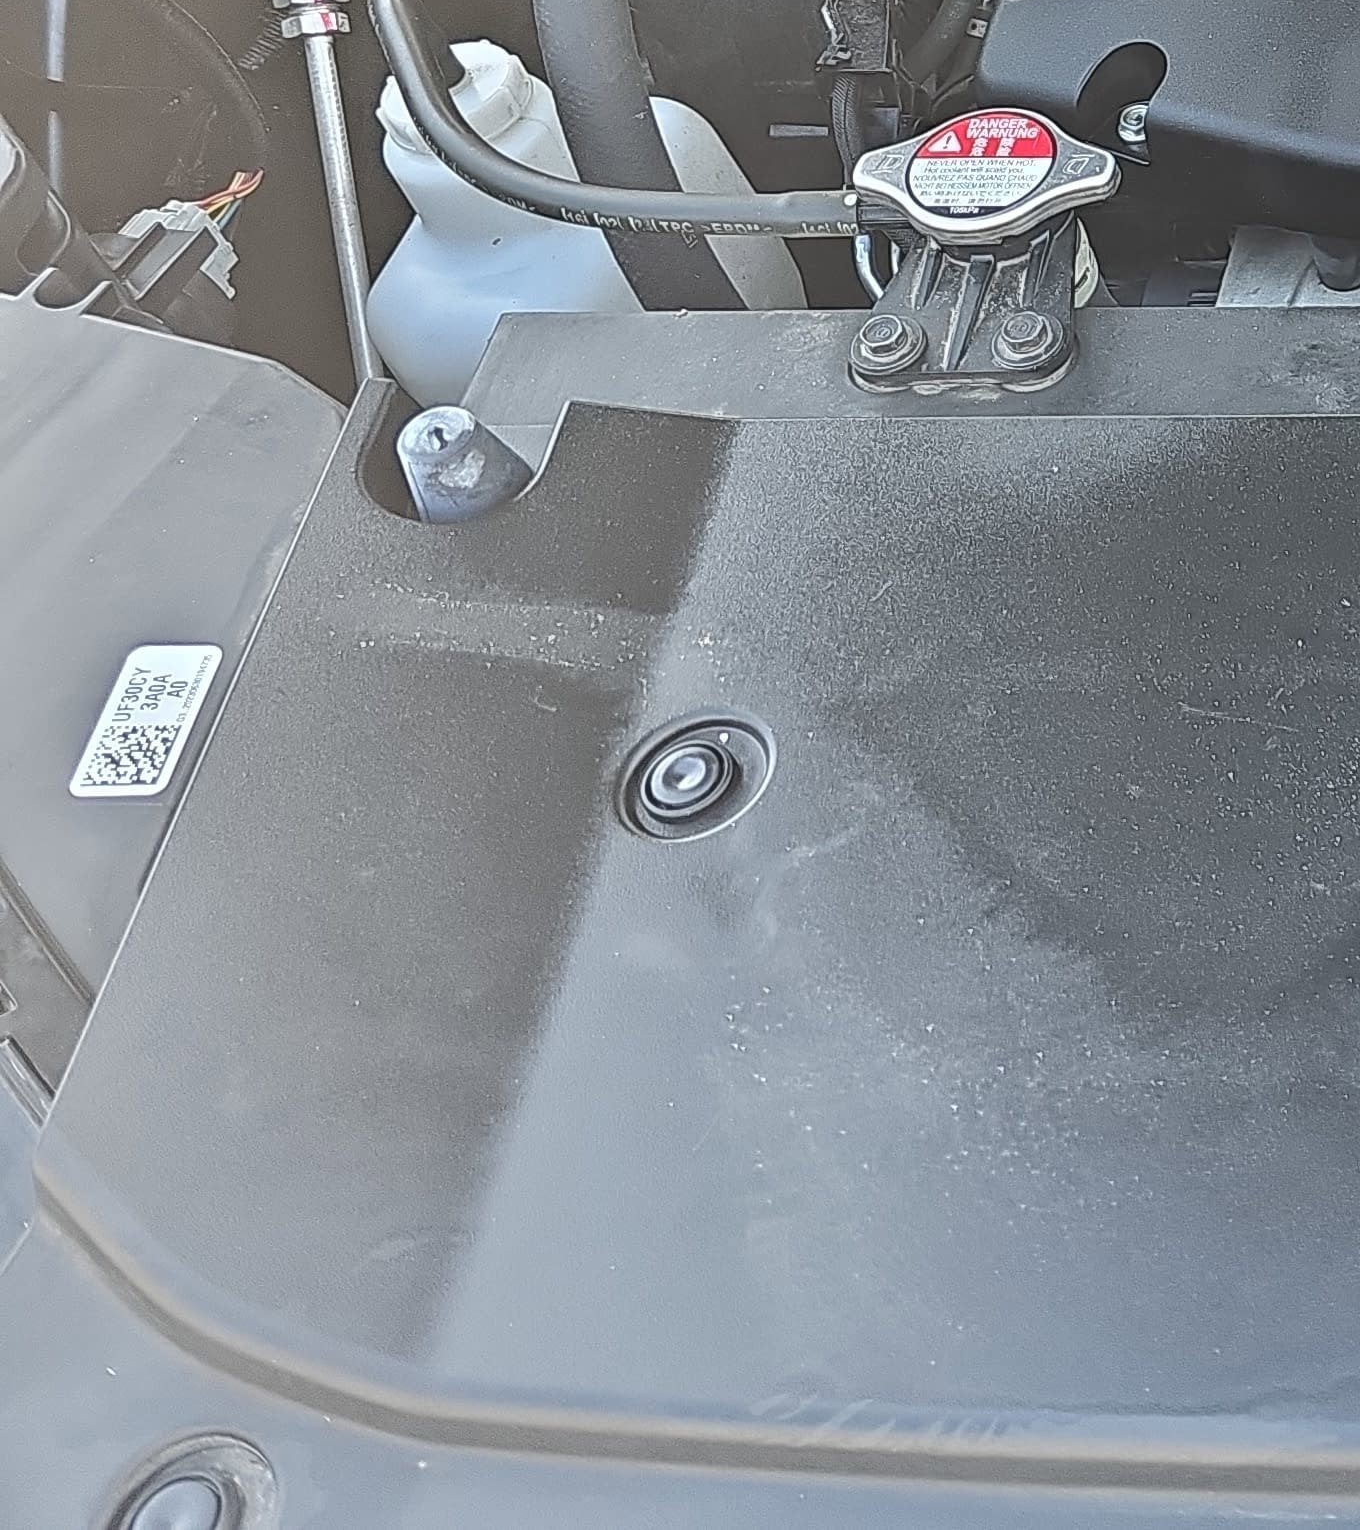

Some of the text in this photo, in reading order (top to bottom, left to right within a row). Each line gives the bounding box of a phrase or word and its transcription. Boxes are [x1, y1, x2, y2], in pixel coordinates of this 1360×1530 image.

[969, 118, 1028, 129] DANGER
[966, 127, 1039, 139] WARNUNG
[927, 159, 958, 167] NEVER
[959, 159, 985, 167] OPEN
[986, 159, 1015, 167] WHEN
[112, 666, 152, 723] UF30CY
[141, 673, 173, 711] 3A0A
[167, 679, 189, 699] A0
